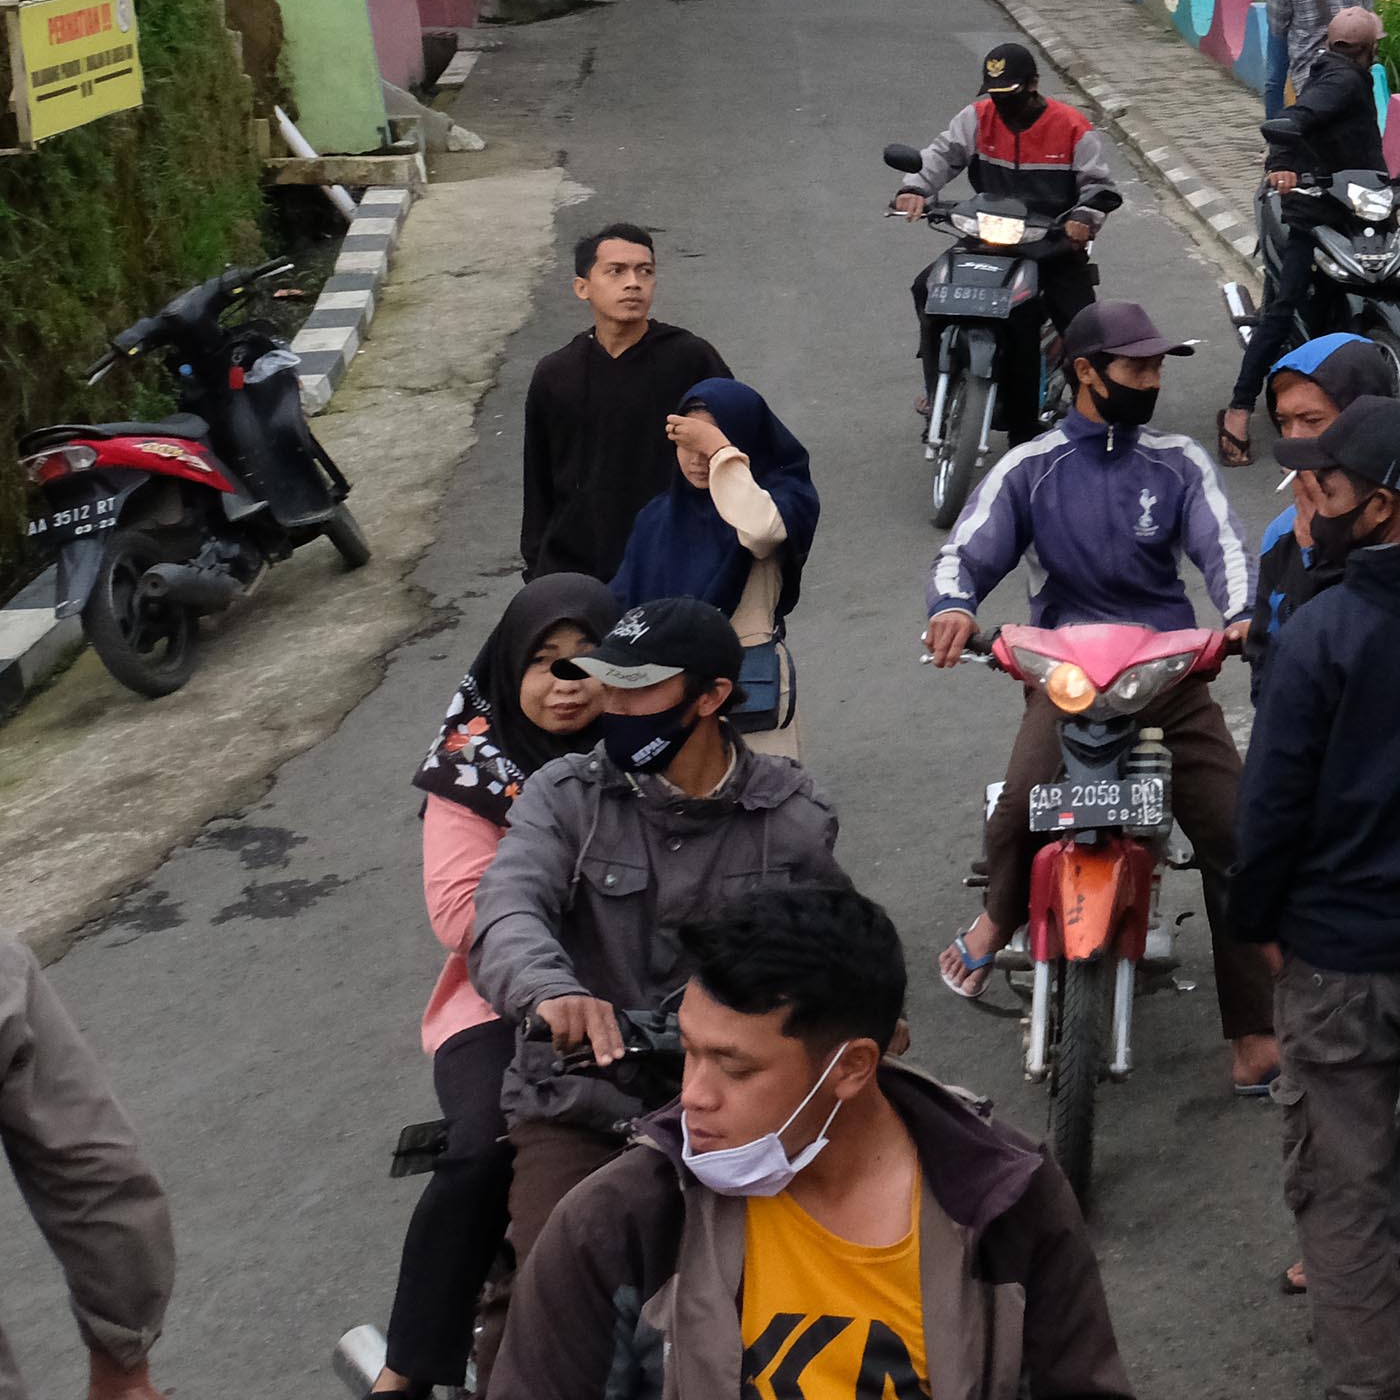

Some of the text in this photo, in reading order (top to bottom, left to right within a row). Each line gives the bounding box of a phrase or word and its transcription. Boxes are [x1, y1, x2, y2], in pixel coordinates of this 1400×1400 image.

[27, 497, 116, 537] AA 3512 RT
[74, 517, 117, 536] 03-23
[1071, 784, 1121, 807] 2058
